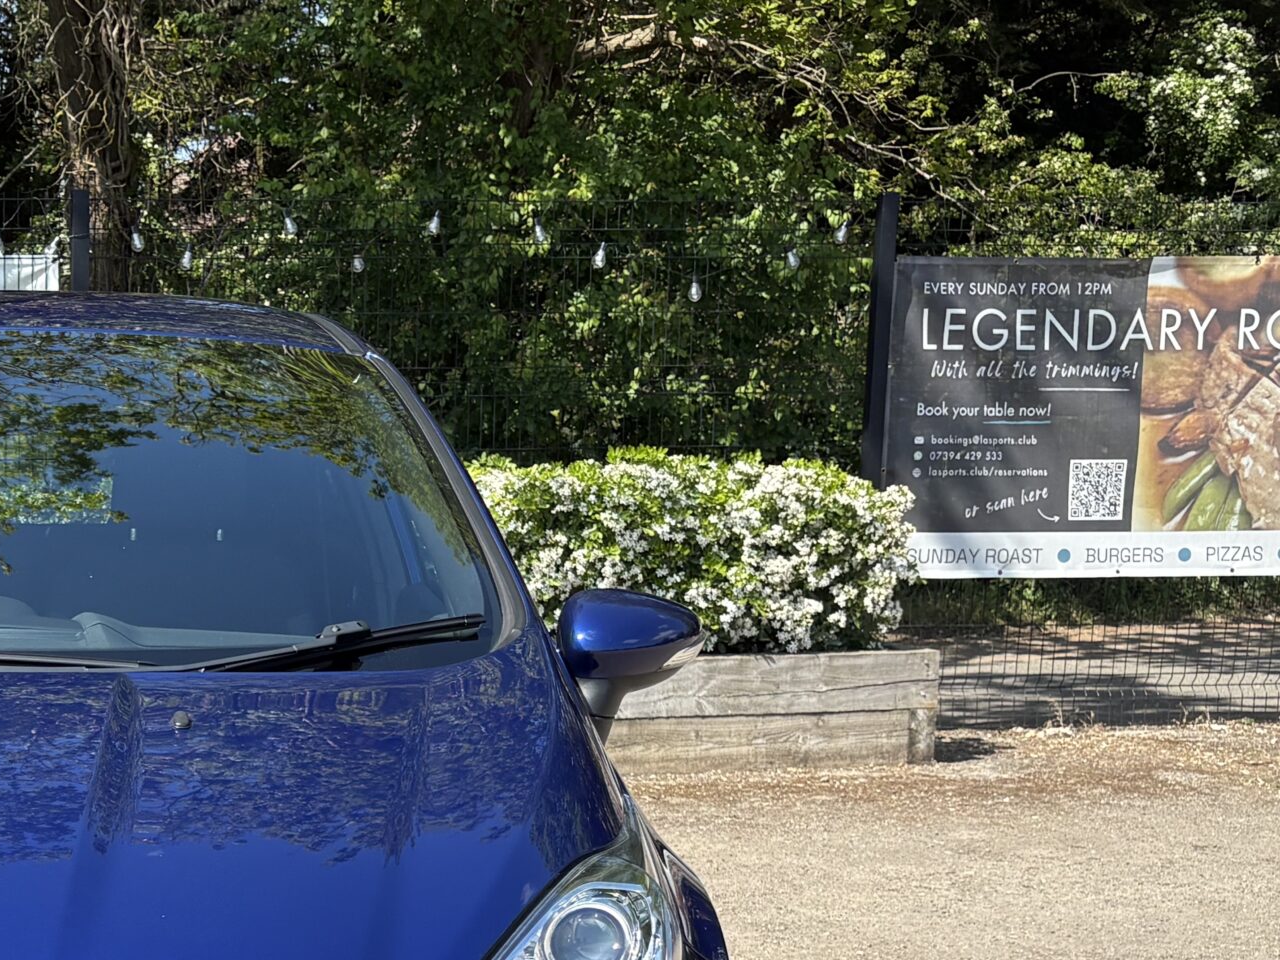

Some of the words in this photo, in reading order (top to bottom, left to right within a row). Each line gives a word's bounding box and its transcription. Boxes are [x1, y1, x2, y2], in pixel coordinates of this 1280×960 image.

[923, 282, 964, 295] EVERY
[969, 282, 1026, 295] SUNDAY
[1031, 282, 1070, 295] FROM
[1077, 282, 1112, 295] 12PM
[922, 307, 1218, 352] LEGENDARY
[931, 360, 968, 379] With
[976, 360, 1002, 378] all
[1011, 360, 1036, 379] the
[1046, 360, 1138, 382] trimmings!
[917, 401, 948, 416] Book
[952, 406, 979, 420] your
[983, 401, 1014, 417] table
[1019, 403, 1051, 417] now!
[931, 435, 1037, 446] bookings@lasports.club
[929, 451, 960, 461] 07394
[964, 451, 982, 461] 429
[985, 451, 1003, 461] 533
[965, 505, 979, 518] or
[986, 497, 1015, 514] scan
[1021, 487, 1048, 505] here
[907, 547, 981, 564] SUNDAY
[985, 547, 1043, 564] ROAST
[1085, 547, 1164, 563] BURGERS
[1206, 545, 1263, 562] PIZZAS
